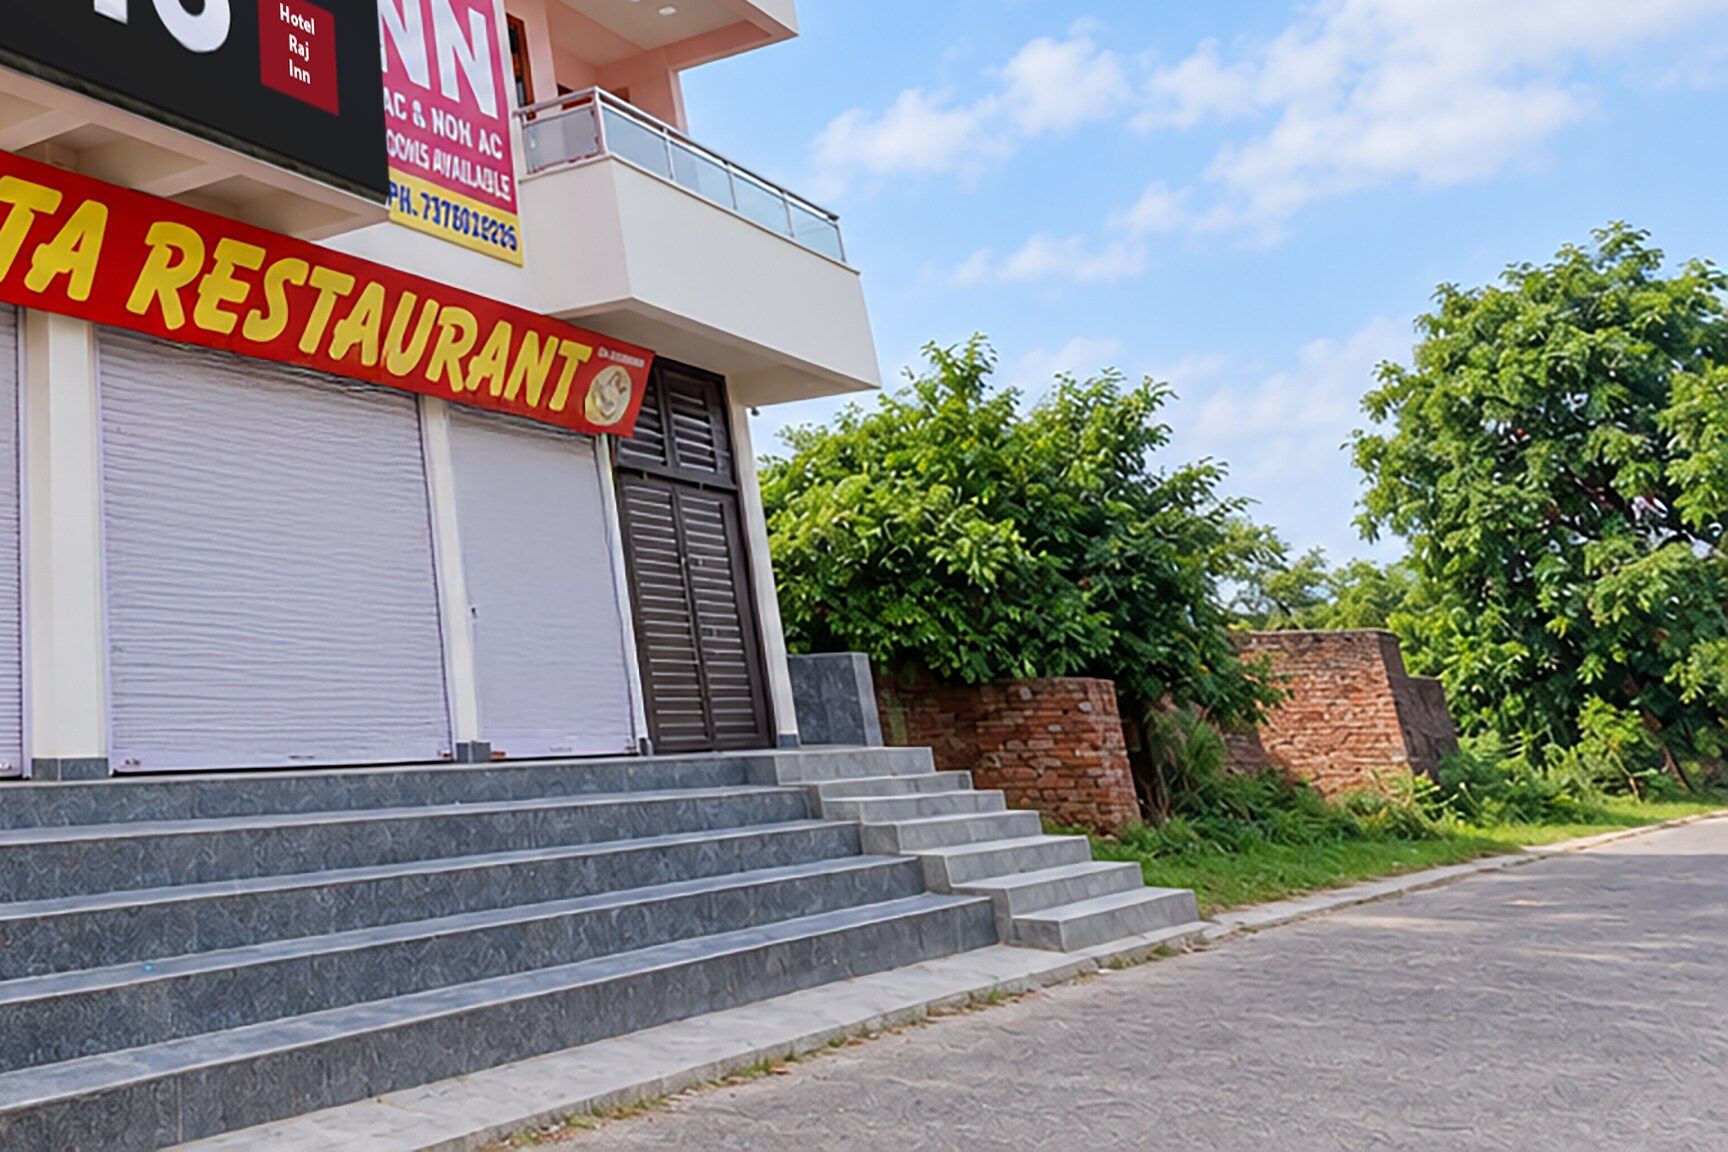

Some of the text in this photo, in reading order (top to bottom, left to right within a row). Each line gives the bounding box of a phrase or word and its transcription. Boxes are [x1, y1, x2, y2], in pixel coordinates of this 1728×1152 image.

[278, 3, 316, 36] Hotel
[288, 34, 311, 63] Raj
[288, 59, 312, 86] Inn
[383, 86, 408, 121] AC
[412, 100, 427, 129] &
[478, 128, 504, 161] AC
[432, 149, 512, 202] AVAILABLE
[125, 220, 594, 412] RESTAURANT
